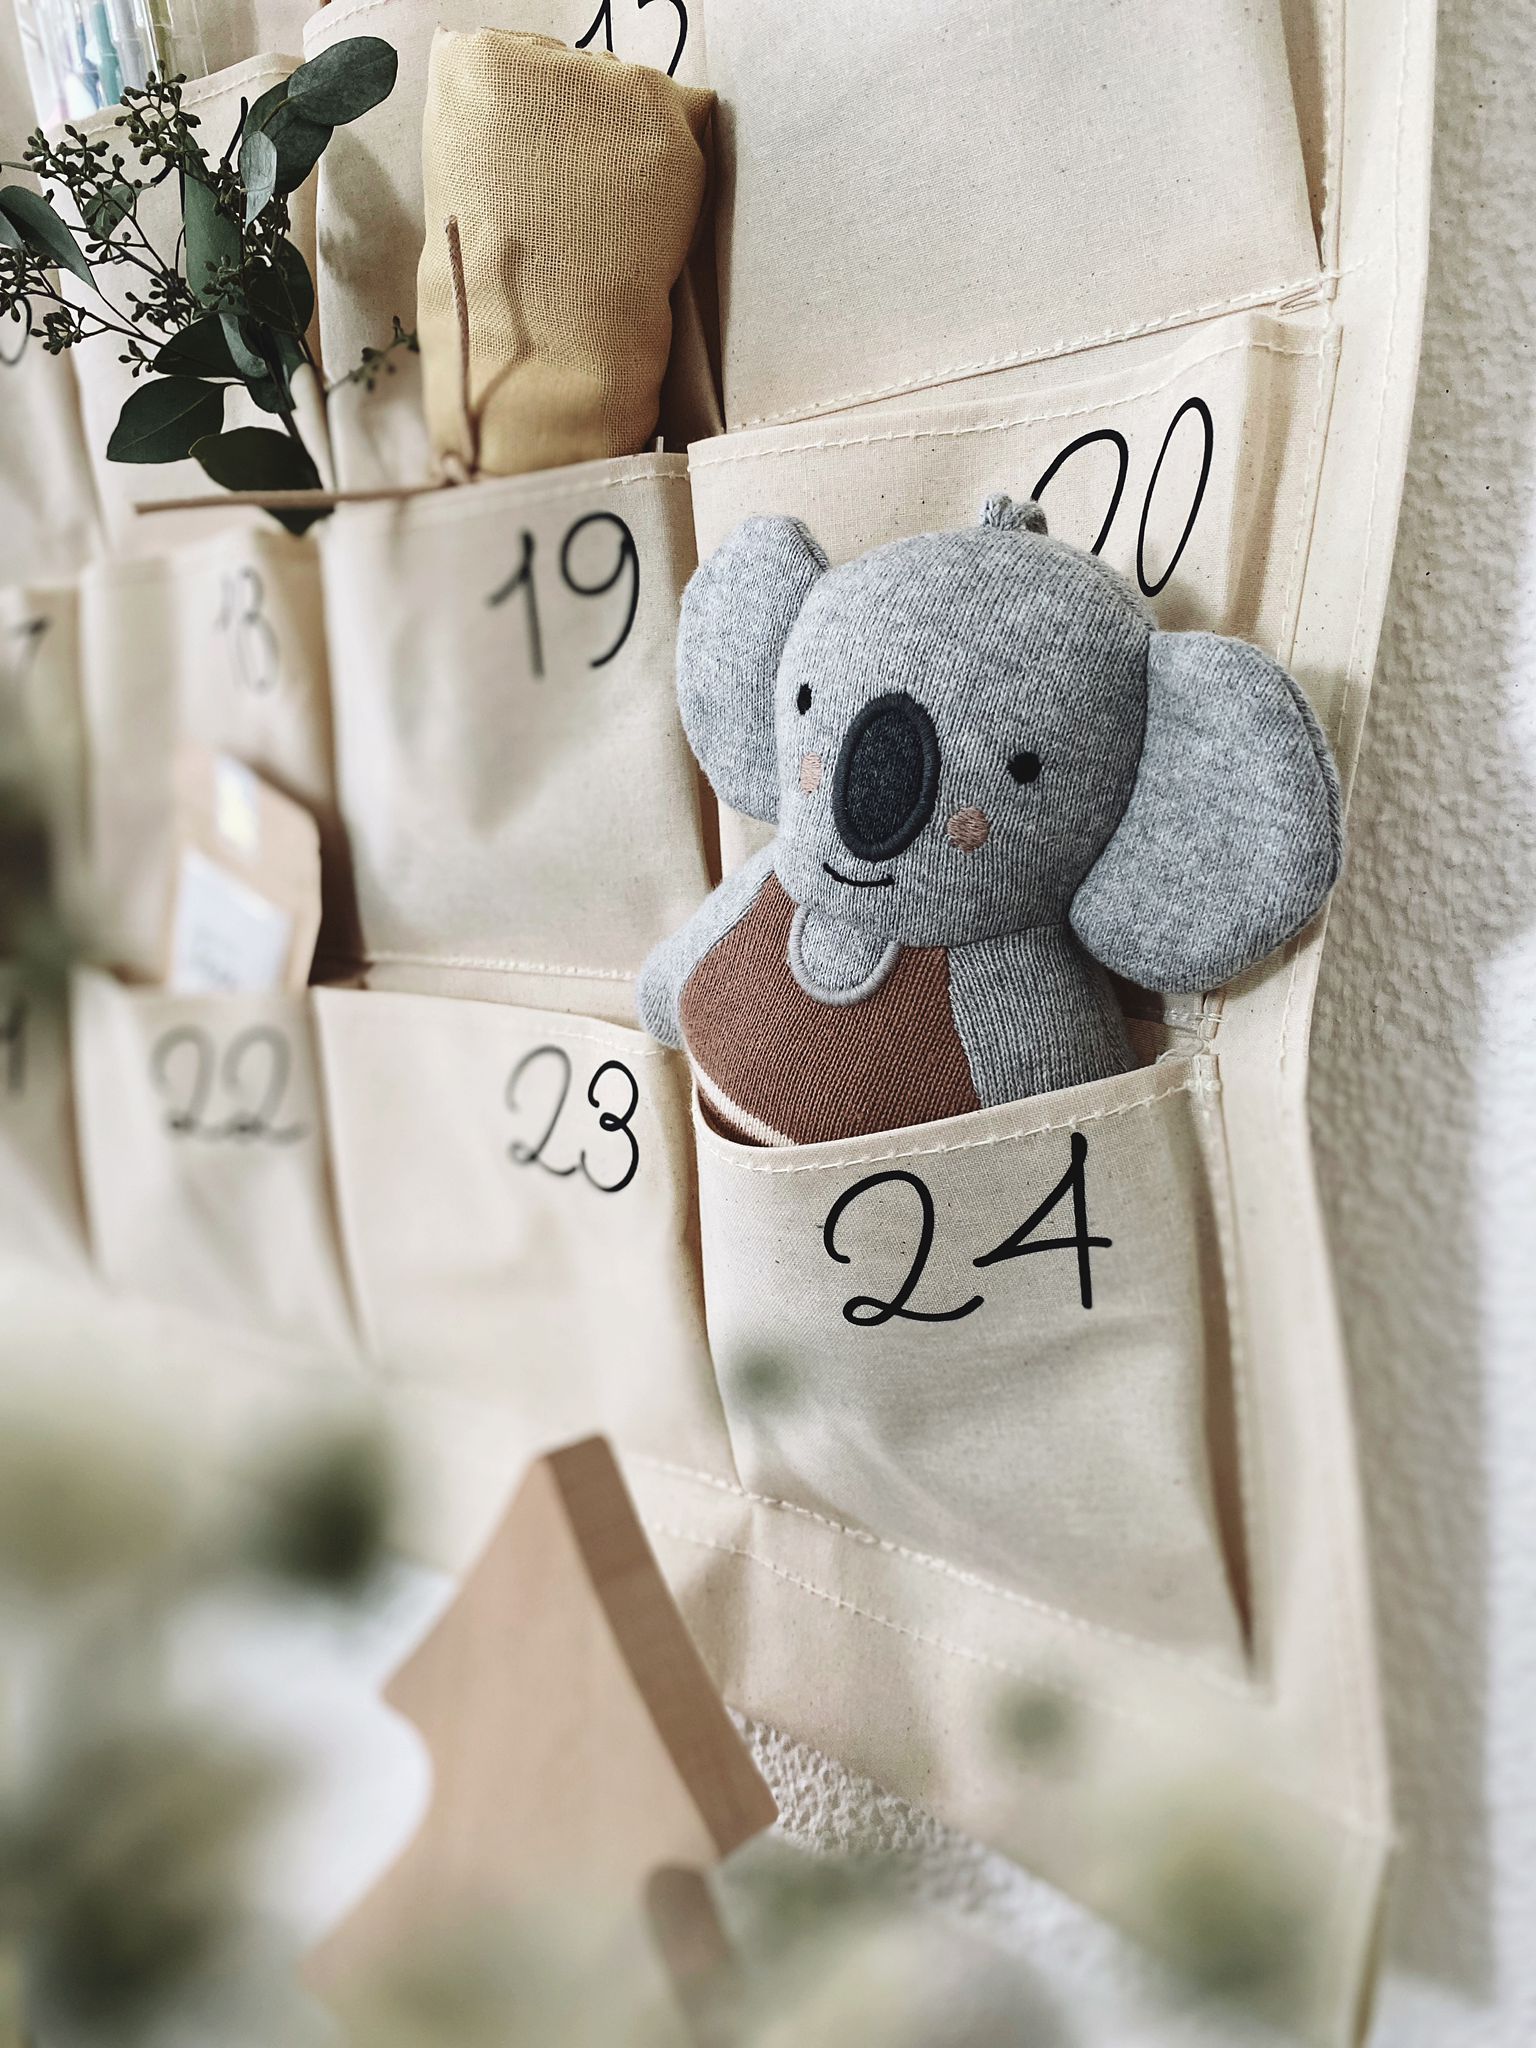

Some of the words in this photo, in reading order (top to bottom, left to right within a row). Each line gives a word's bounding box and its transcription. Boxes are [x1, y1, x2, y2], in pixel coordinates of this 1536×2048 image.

[486, 512, 640, 677] 19
[150, 1023, 308, 1145] 22
[505, 1045, 640, 1193] 23
[823, 1132, 1113, 1326] 24
